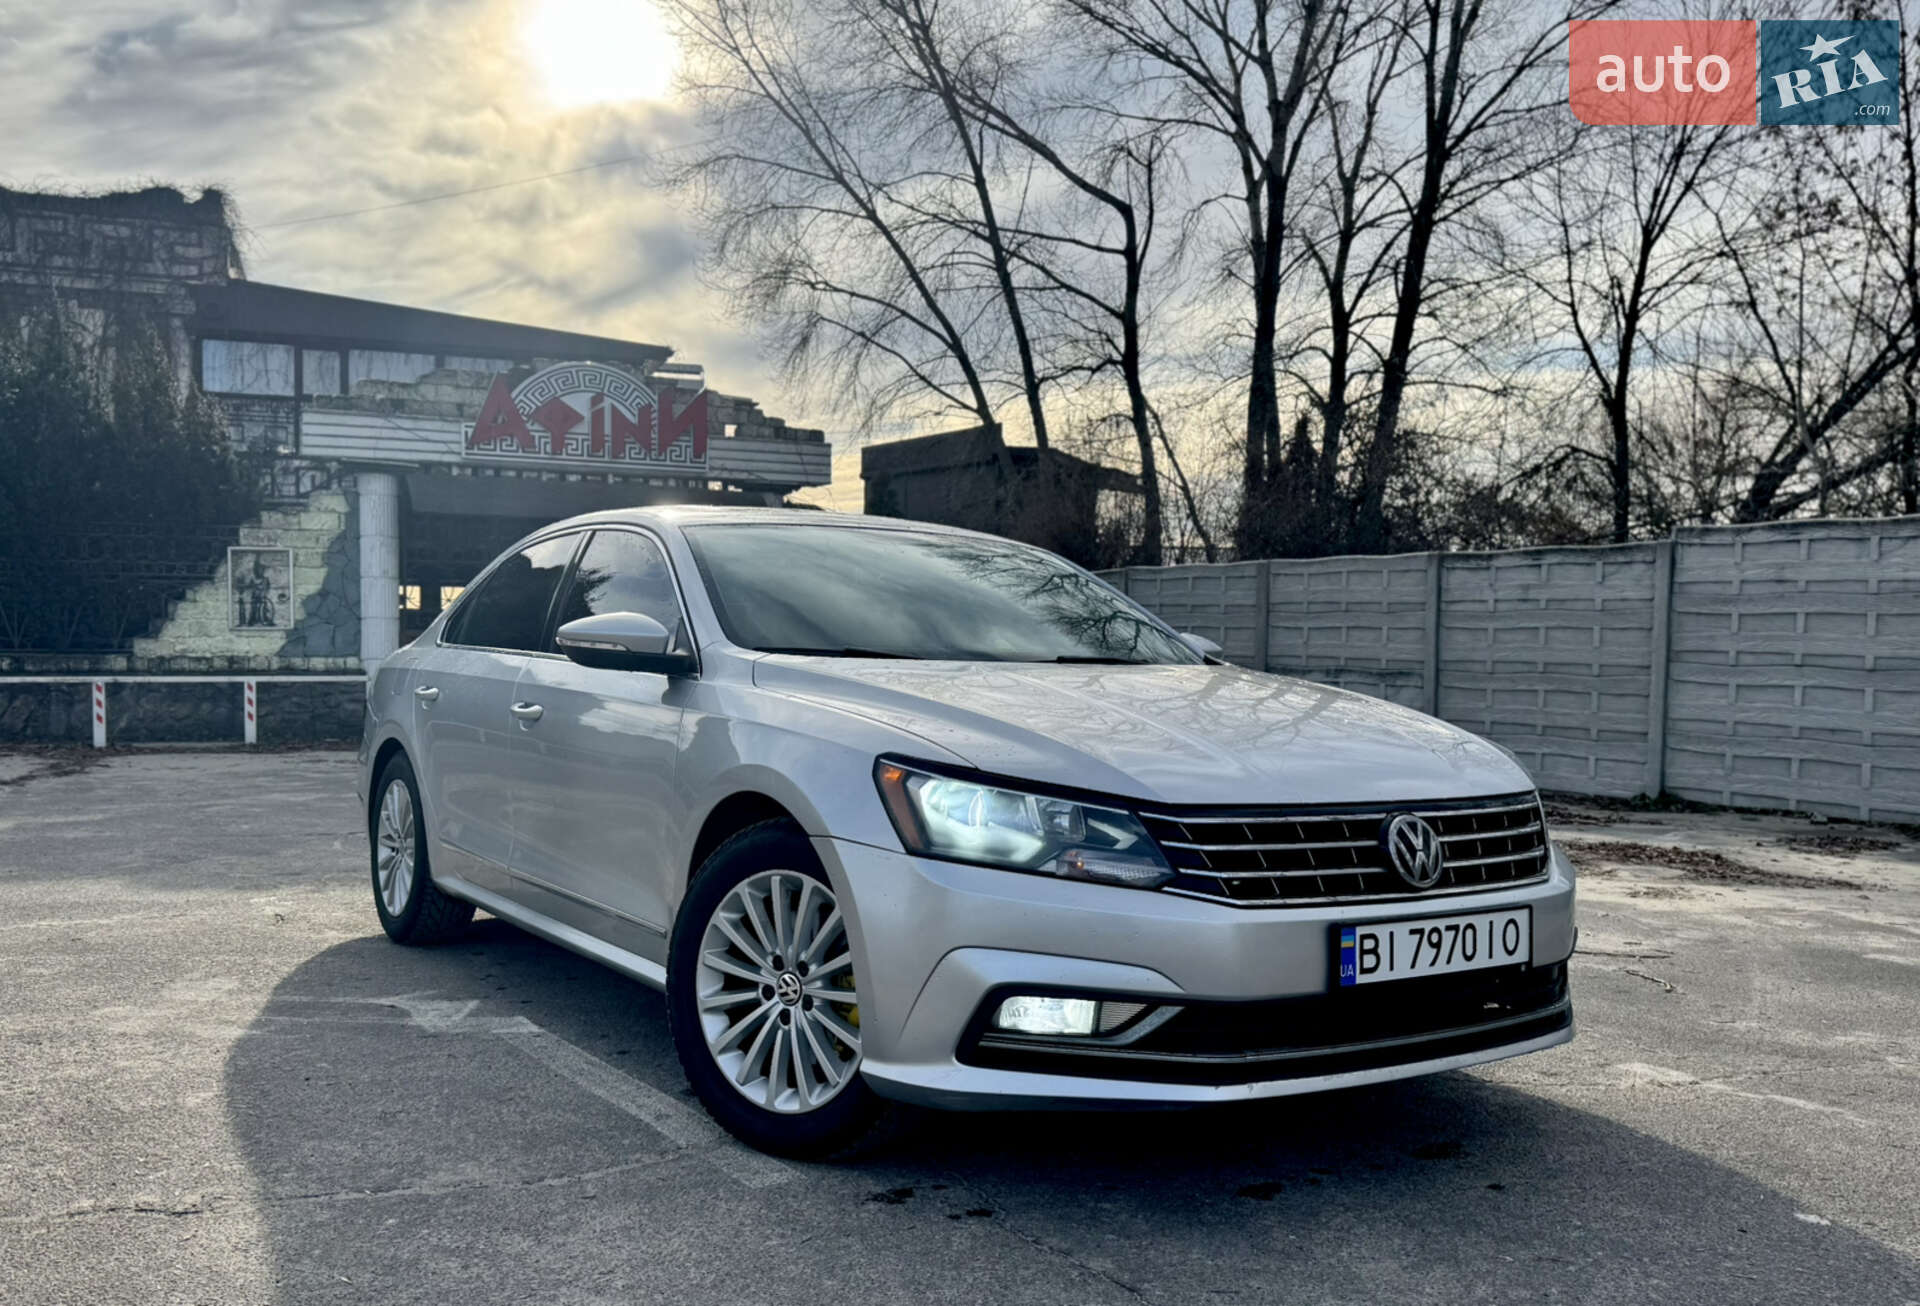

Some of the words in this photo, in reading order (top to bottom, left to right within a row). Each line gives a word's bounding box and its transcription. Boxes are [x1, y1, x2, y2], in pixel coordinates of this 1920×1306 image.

[1358, 930, 1395, 976] BI
[1408, 922, 1478, 970] 7970
[1488, 918, 1521, 960] IO
[1340, 963, 1355, 978] UA
